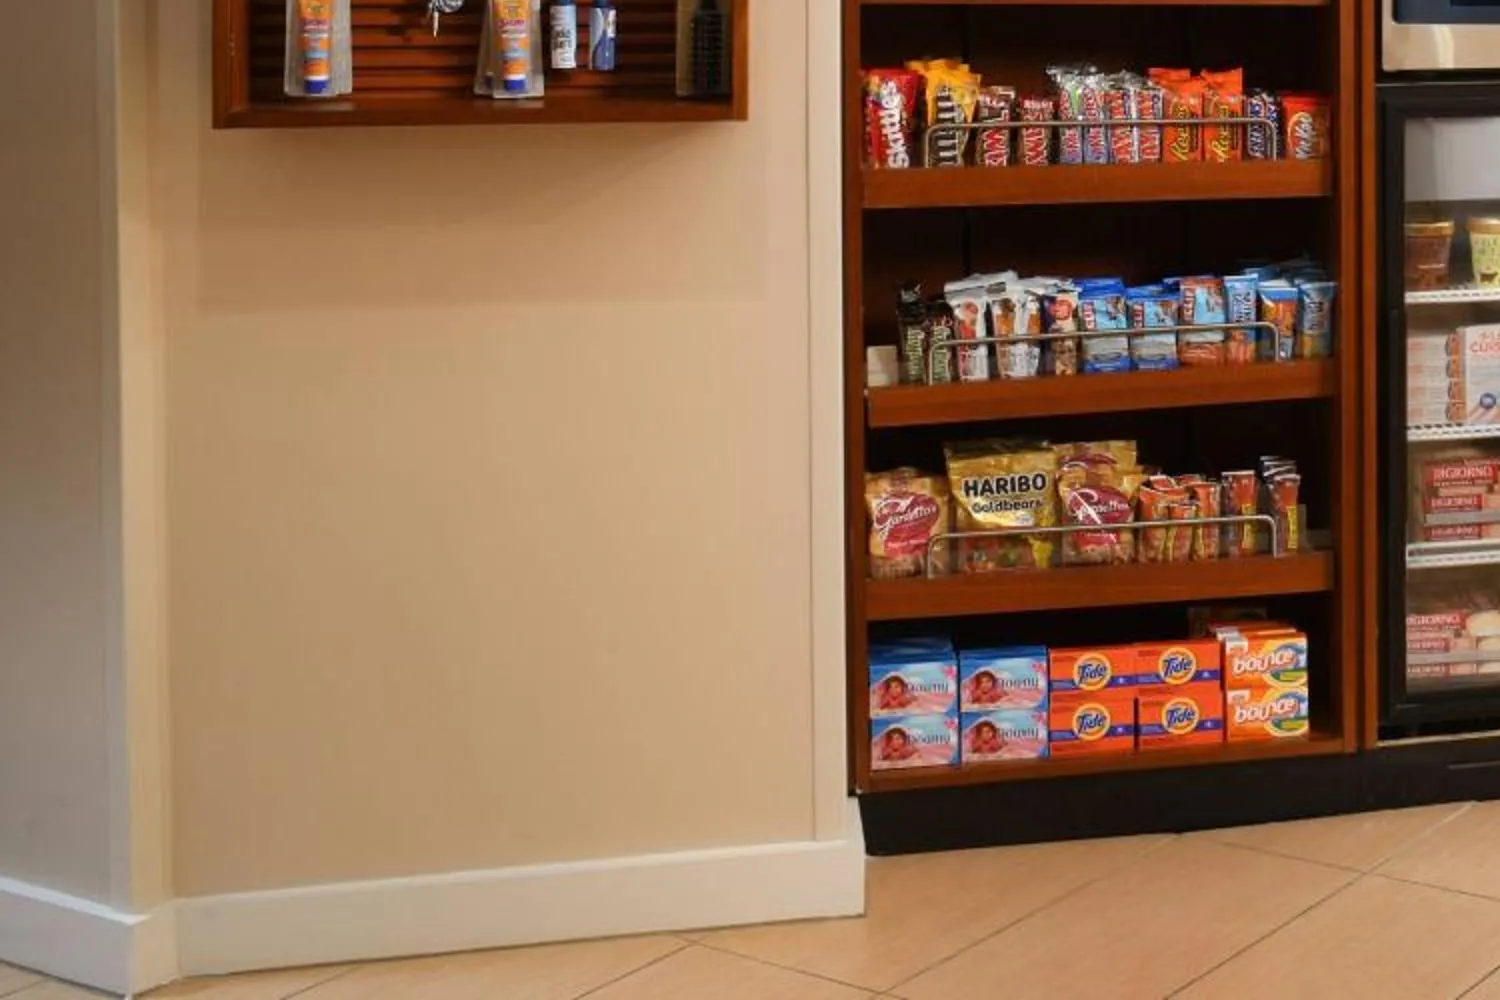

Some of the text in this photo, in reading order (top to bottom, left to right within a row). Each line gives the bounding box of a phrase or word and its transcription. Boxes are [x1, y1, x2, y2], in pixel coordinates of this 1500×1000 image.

[880, 81, 910, 169] Skittles
[963, 473, 1047, 497] HARIBO
[972, 499, 1042, 514] Goldbears
[1161, 655, 1194, 675] Tide
[1233, 649, 1297, 674] bounce
[1077, 662, 1107, 682] Tide
[1166, 707, 1196, 726] Tide
[1235, 698, 1297, 723] bounce
[1077, 712, 1107, 732] Tide
